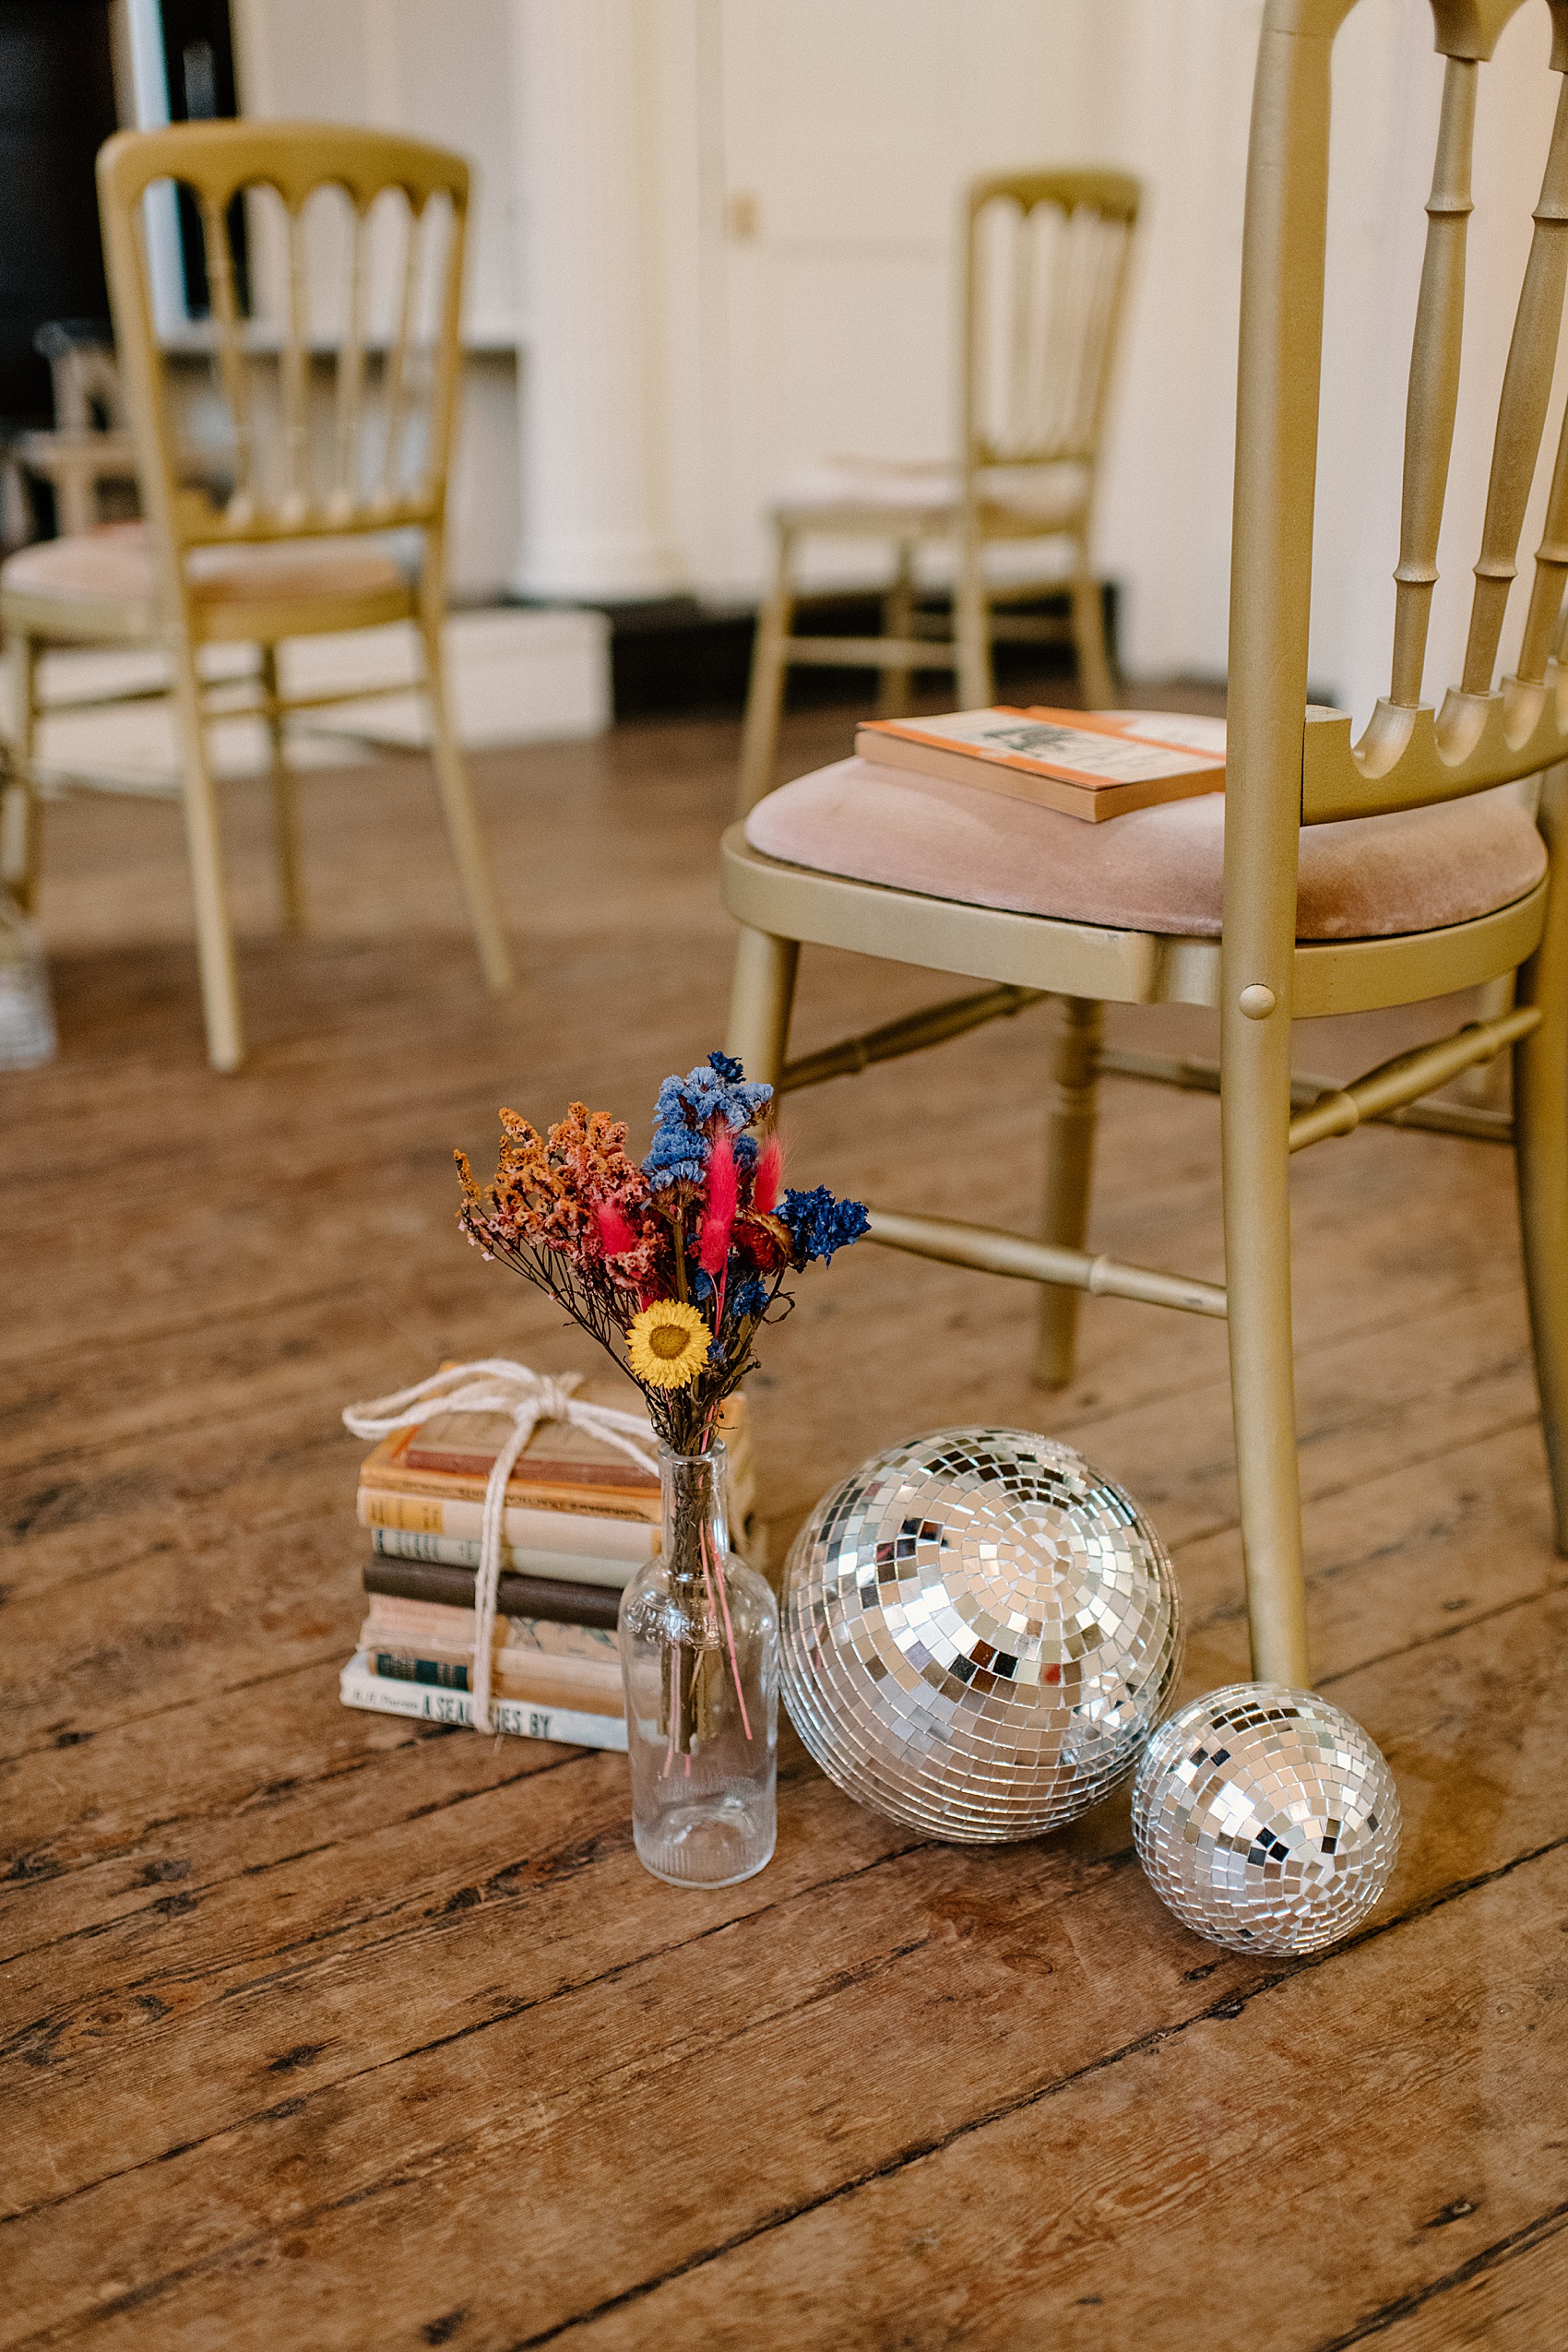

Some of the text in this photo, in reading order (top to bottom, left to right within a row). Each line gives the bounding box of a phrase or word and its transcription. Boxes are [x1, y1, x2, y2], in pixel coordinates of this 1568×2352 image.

[422, 1695, 432, 1719] A
[435, 1697, 473, 1726] SEAL
[529, 1712, 551, 1739] BY
